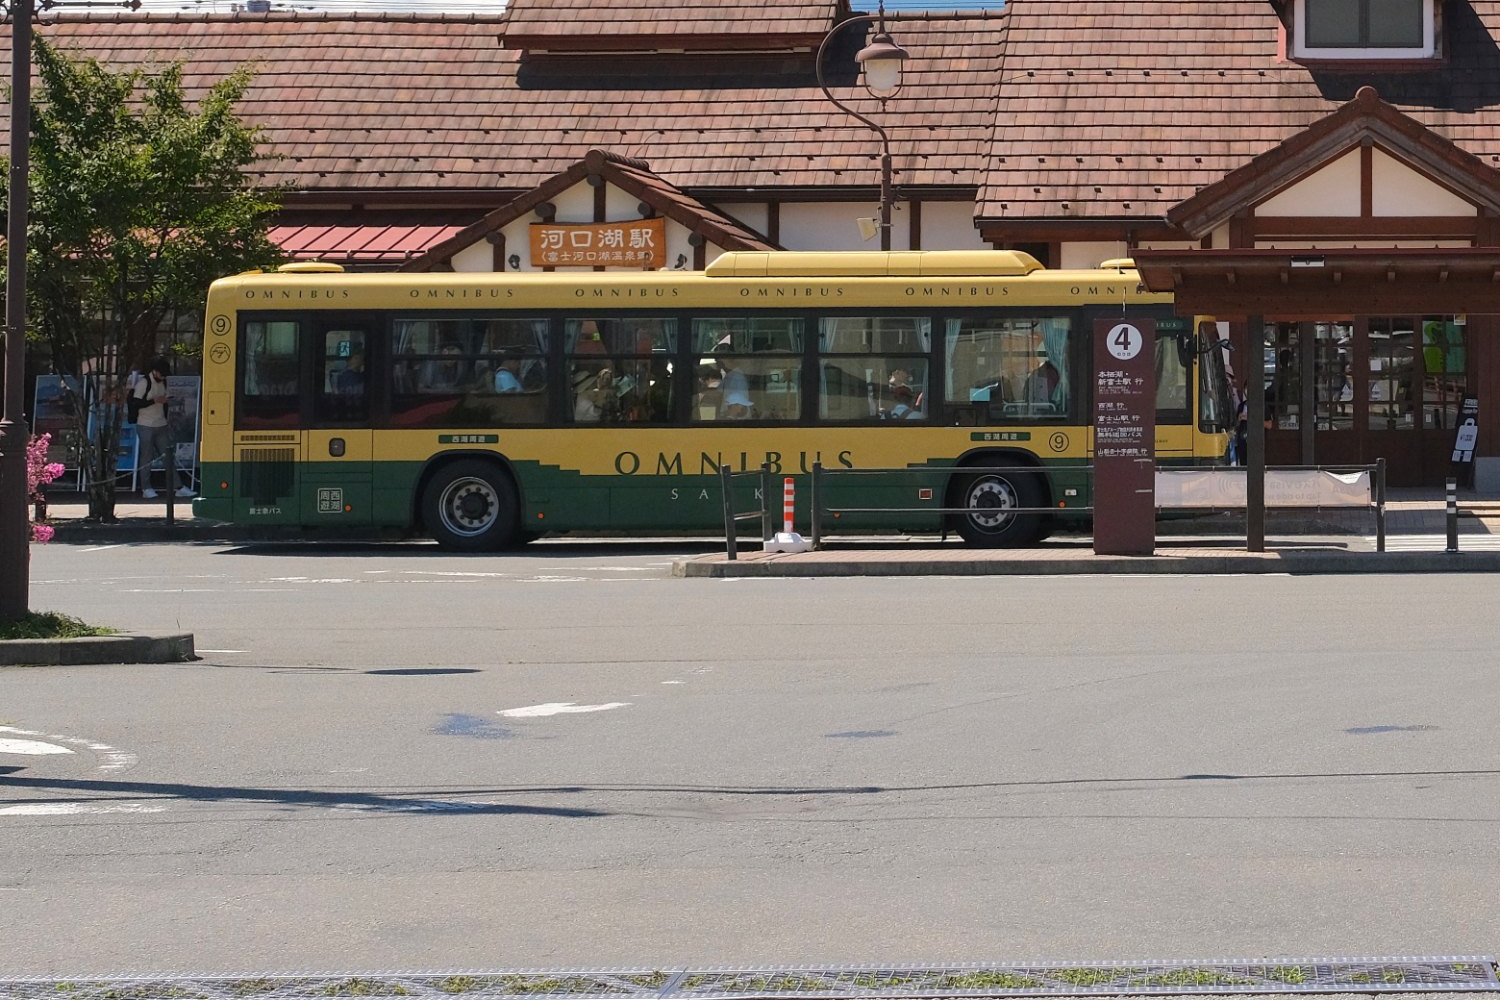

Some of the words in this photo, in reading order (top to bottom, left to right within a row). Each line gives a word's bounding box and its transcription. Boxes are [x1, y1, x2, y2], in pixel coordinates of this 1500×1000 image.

[541, 229, 655, 248] 河口湖駅
[246, 290, 350, 299] OMNIBUS
[409, 288, 514, 298] OMNIBUS
[575, 288, 679, 297] OMNIBUS
[740, 287, 844, 297] OMNIBUS
[905, 287, 1009, 296] OMNIBUS
[1070, 286, 1173, 295] OMNI
[1114, 327, 1131, 350] 4
[614, 451, 853, 476] OMNIBUS
